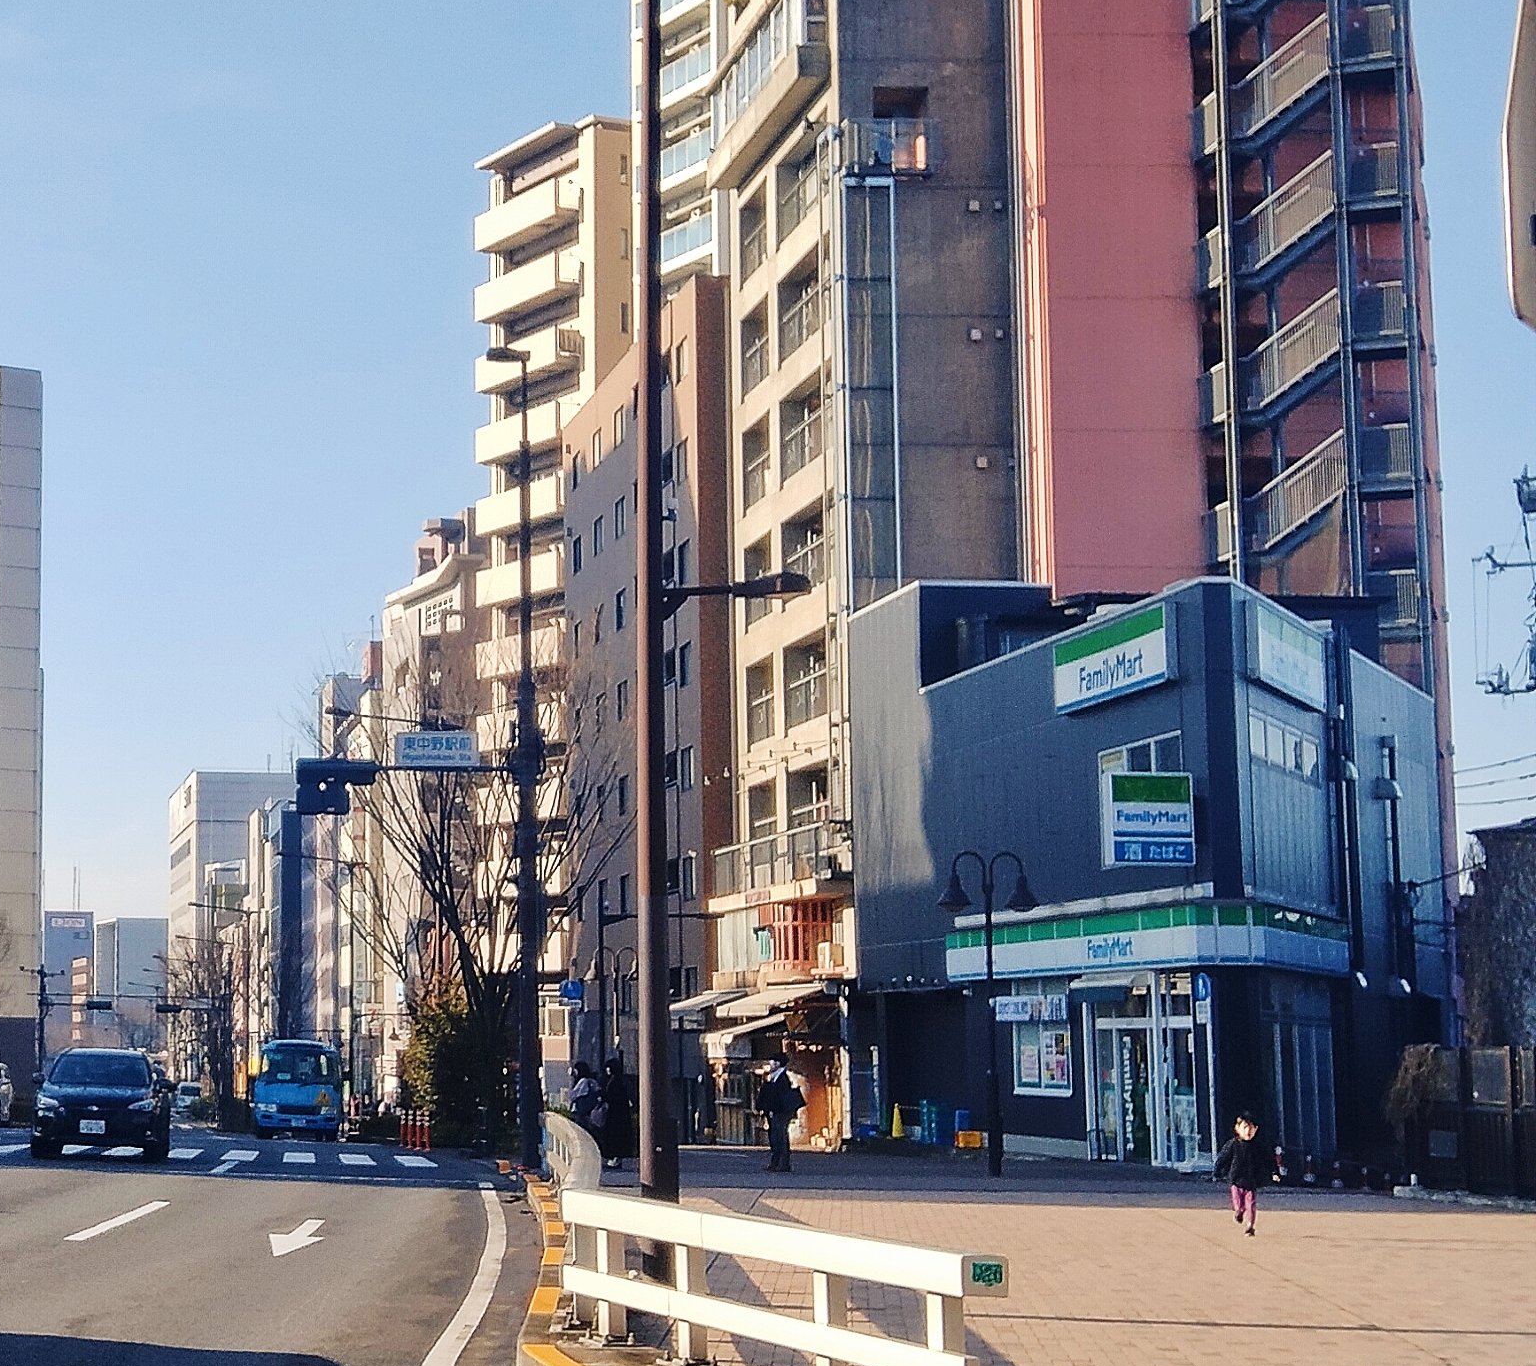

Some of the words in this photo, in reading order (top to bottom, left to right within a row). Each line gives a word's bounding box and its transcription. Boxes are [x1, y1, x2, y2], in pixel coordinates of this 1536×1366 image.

[1078, 648, 1143, 695] FamilyMart
[1116, 809, 1189, 826] FamilyMart
[1149, 844, 1186, 860] たばこ
[1086, 936, 1134, 963] FamilyMart
